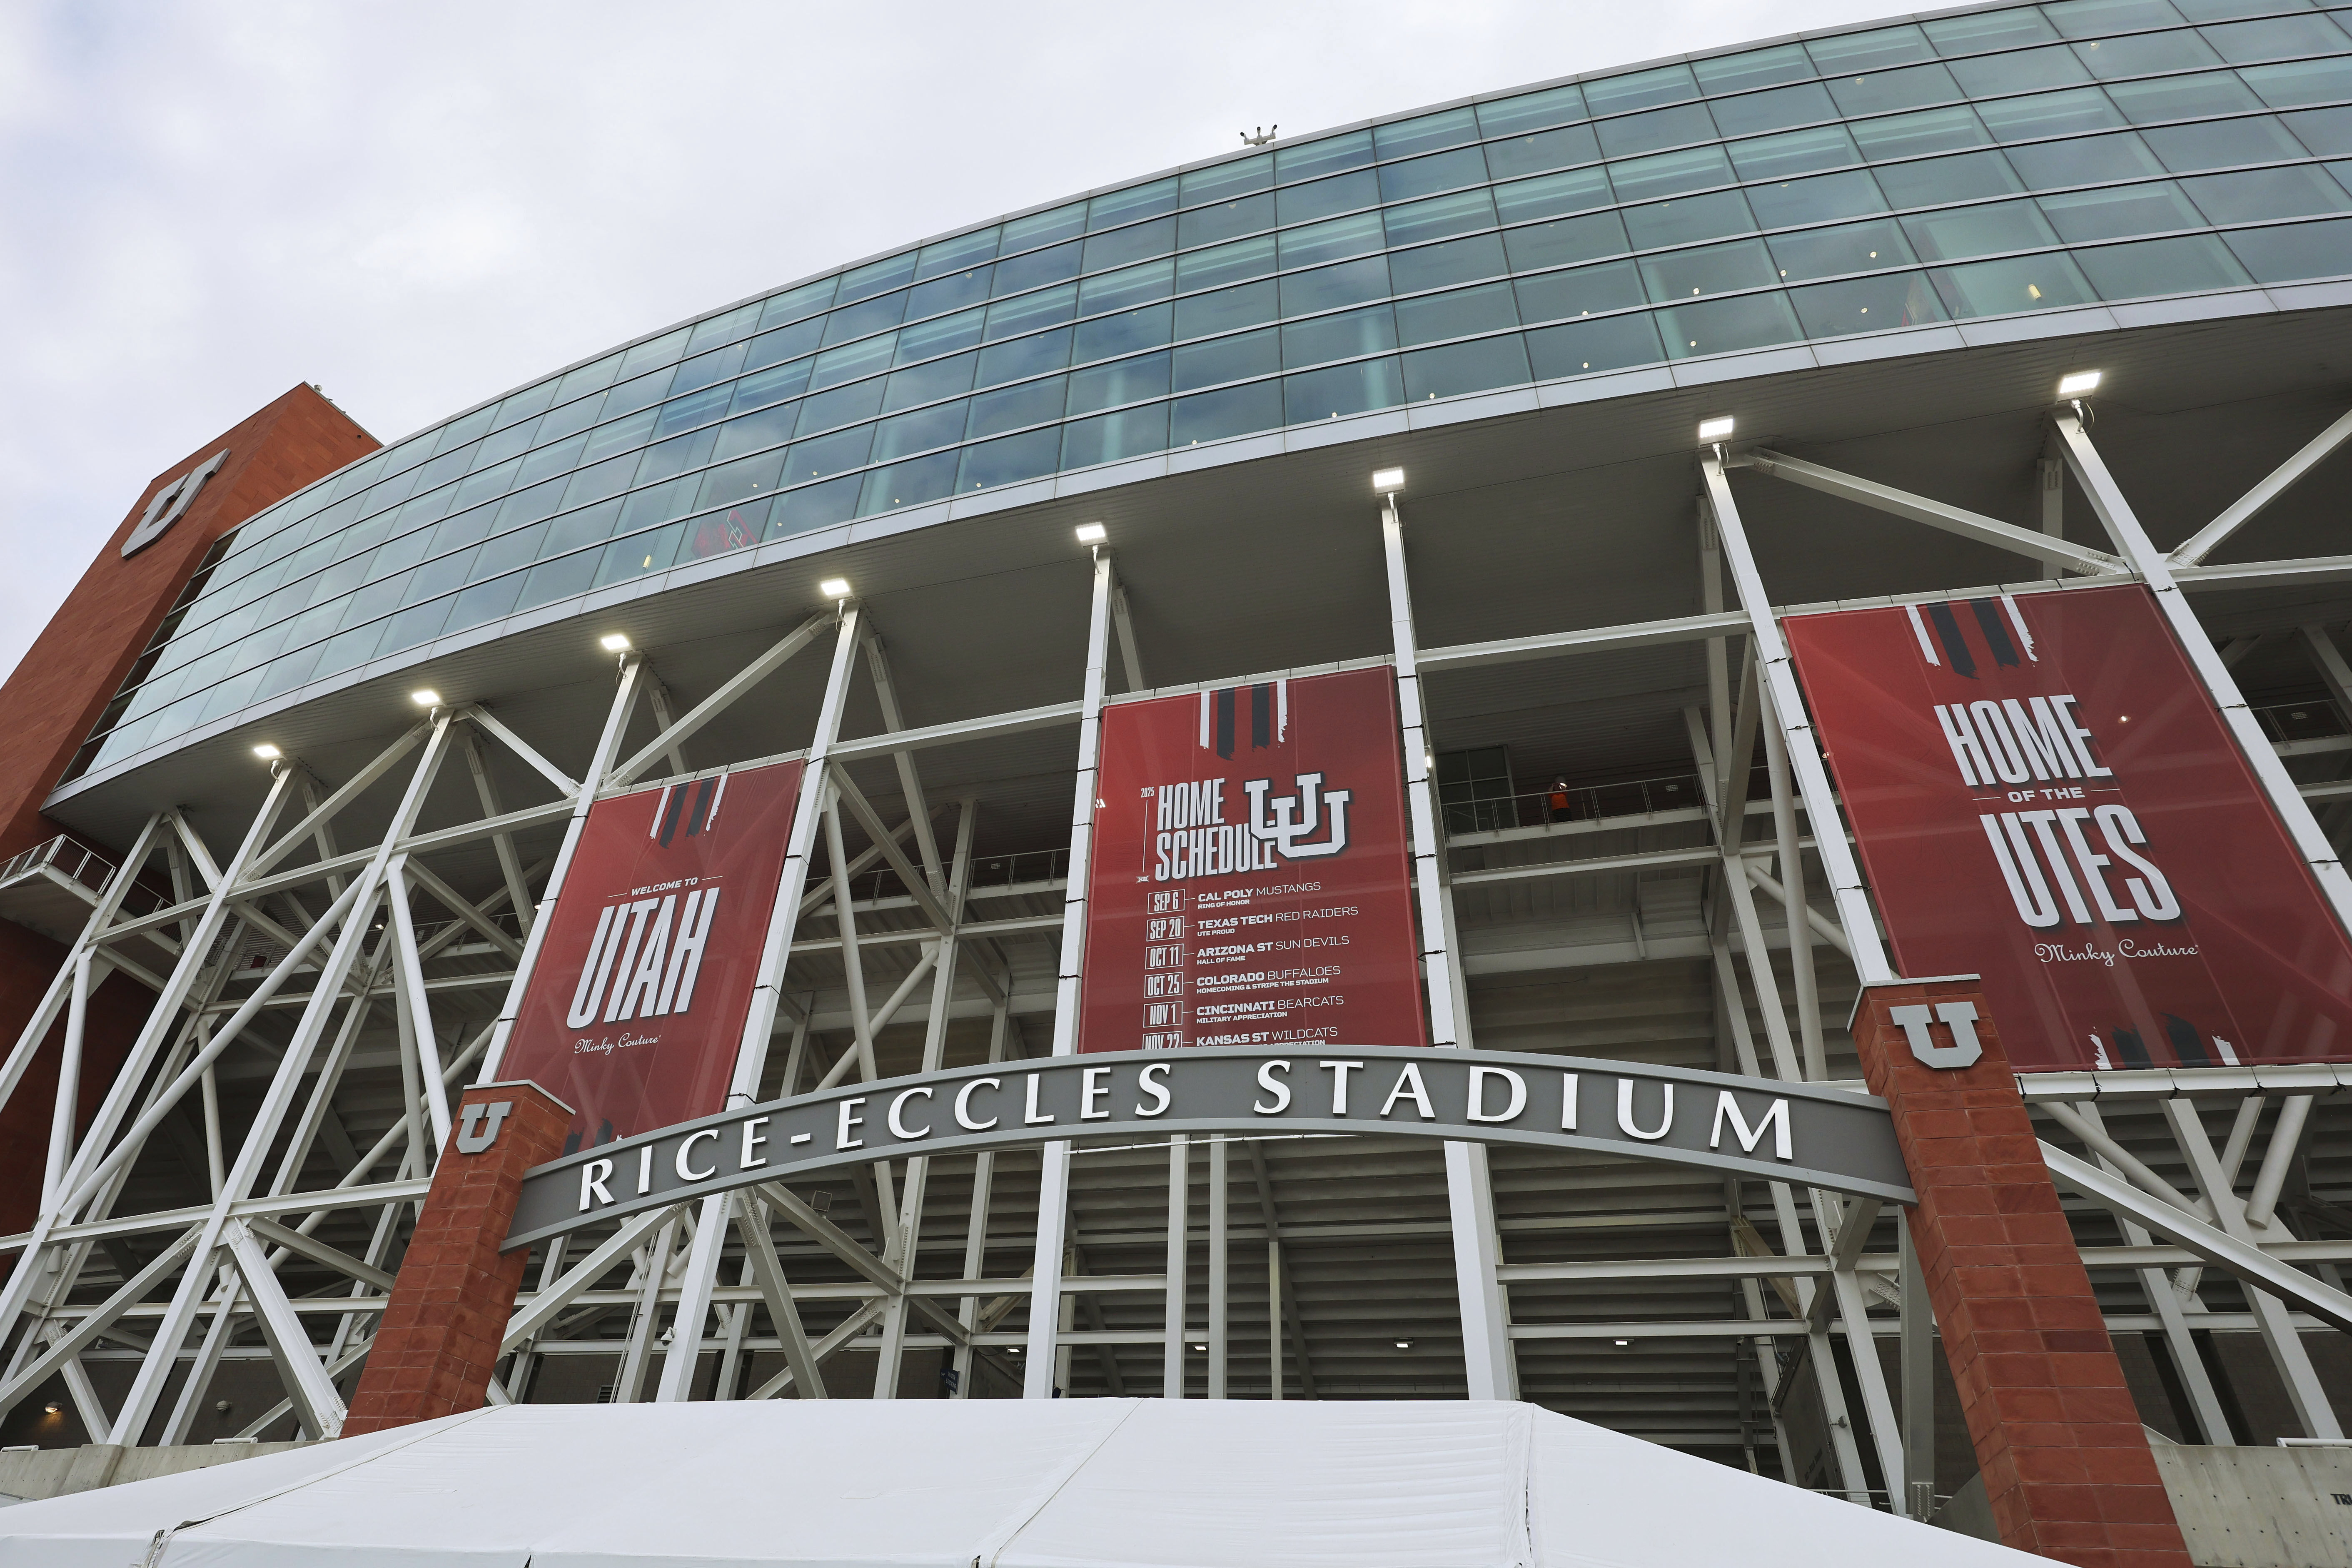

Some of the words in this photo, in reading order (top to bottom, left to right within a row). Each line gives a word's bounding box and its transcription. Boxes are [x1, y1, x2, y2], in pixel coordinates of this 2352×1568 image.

[121, 448, 231, 560] U
[1933, 694, 2113, 786] HOME
[1141, 787, 1154, 798] 2025
[2008, 790, 2035, 802] OF
[2040, 787, 2085, 800] THE
[1157, 778, 1225, 831] HOME
[1155, 821, 1277, 881] SCHEDULE
[1979, 805, 2180, 927] UTES
[632, 880, 682, 896] WELCOME
[685, 877, 698, 886] TO
[1198, 892, 1221, 902] CAL
[1224, 888, 1253, 899] POLY
[1257, 882, 1320, 896] MUSTANGS
[1154, 893, 1171, 912] SEP
[1173, 892, 1178, 909] 6
[1198, 917, 1238, 929] TEXAS
[1240, 914, 1272, 925] TECH
[1276, 912, 1299, 922] RED
[1303, 907, 1358, 919] RAIDERS
[1150, 921, 1167, 939] SEP
[1168, 919, 1182, 938] 20
[1150, 947, 1167, 967] OCT
[1170, 947, 1179, 966] 11
[1197, 944, 1255, 957] ARIZONA
[1257, 942, 1273, 952] ST
[1275, 939, 1303, 950] SUN
[1304, 936, 1349, 947] DEVILS
[2035, 943, 2115, 966] Minky
[2119, 939, 2198, 957] Couture
[567, 887, 720, 1028] UTAH
[1148, 977, 1165, 996] OCT
[1167, 975, 1180, 995] 25
[1197, 972, 1265, 986] COLORADO
[1267, 966, 1341, 980] BUFFALOES
[1197, 985, 1245, 994] HOMECOMING
[1149, 1004, 1169, 1025] NOV
[1171, 1004, 1175, 1023] 1
[1197, 1001, 1275, 1016] CINCINNATI
[1278, 996, 1344, 1009] BEARCATS
[1233, 1012, 1287, 1021] APPRECIATION
[574, 1037, 614, 1055] Minky
[619, 1033, 661, 1047] Couture
[1145, 1035, 1167, 1049] NOV
[1167, 1033, 1180, 1048] 22
[1197, 1034, 1250, 1046] KANSAS
[1252, 1032, 1269, 1042] ST
[1272, 1027, 1337, 1040] WILDCATS
[1889, 1001, 1983, 1069] U
[455, 1101, 512, 1154] U
[579, 1062, 1172, 1213] RICE-ECCLES
[1252, 1059, 1794, 1162] STADIUM
